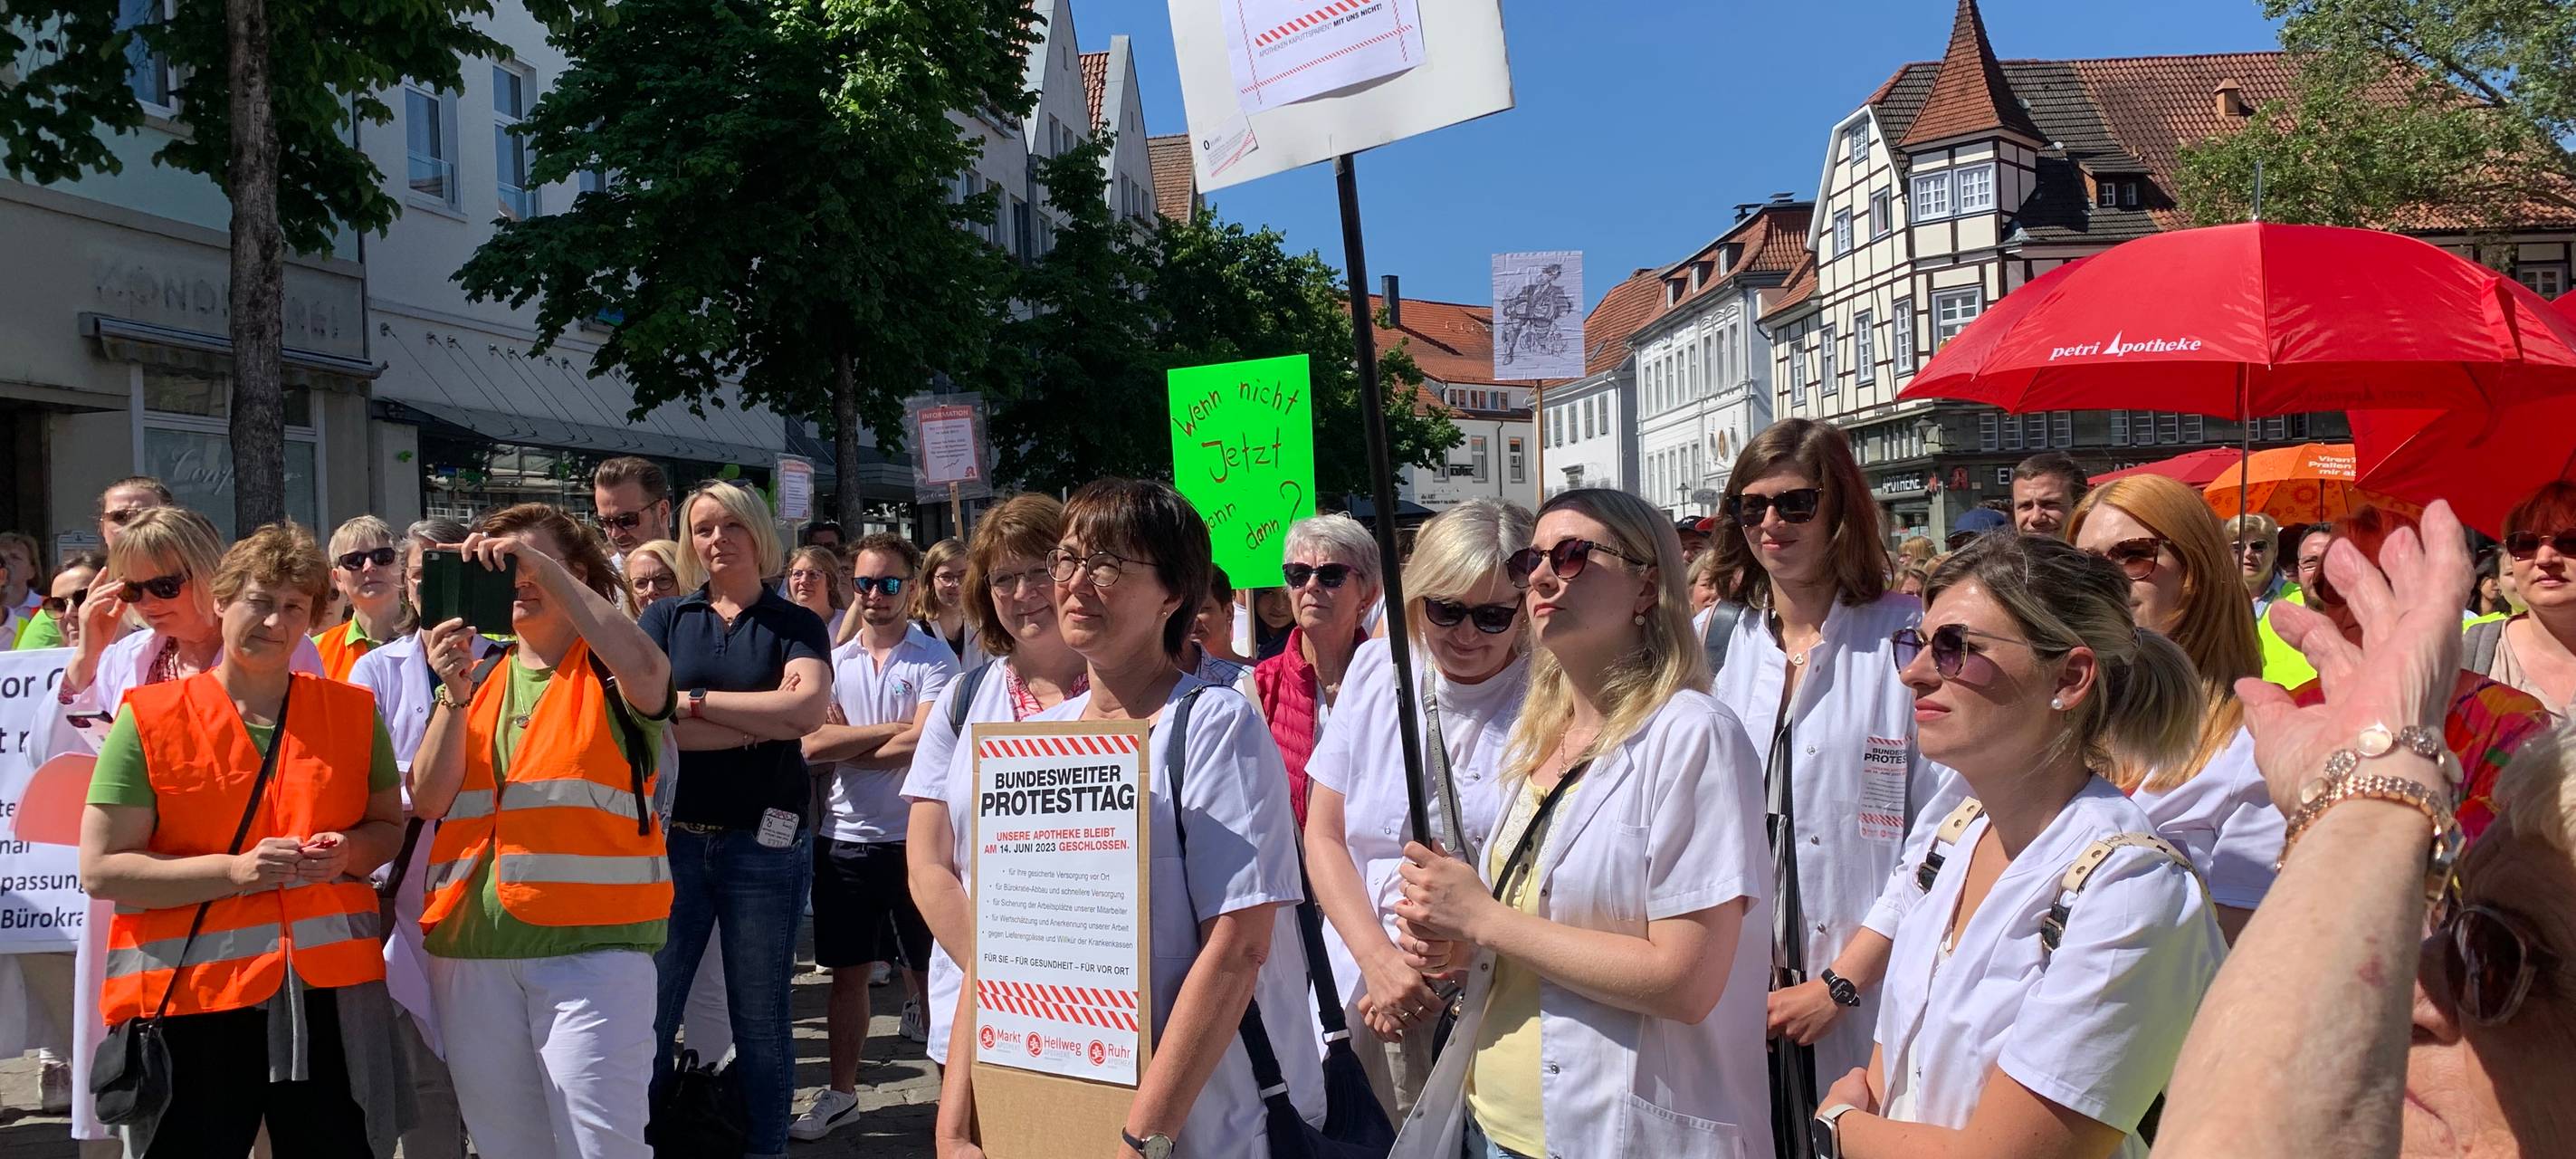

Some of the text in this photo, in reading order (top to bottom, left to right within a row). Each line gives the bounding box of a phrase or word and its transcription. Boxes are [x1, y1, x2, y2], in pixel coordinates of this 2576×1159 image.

[1333, 18, 1345, 28] MIT
[1346, 12, 1360, 23] UNS
[1360, 3, 1383, 17] NICHT!
[2048, 341, 2101, 361] petri
[1238, 378, 1300, 415] nicht
[921, 409, 968, 420] INFORMATION
[1201, 426, 1282, 484] Jetzt
[2308, 460, 2352, 469] Prallen
[1882, 472, 1921, 494] APOTHEKE
[1245, 519, 1281, 551] dann
[1, 675, 36, 699] or
[1865, 752, 1906, 764] PROTES
[1873, 747, 1905, 755] BUNDES
[996, 764, 1121, 790] BUNDESWEITER
[981, 783, 1135, 817] PROTESTTAG
[997, 828, 1115, 841] UNSERE APOTHEKE BLEIBT
[984, 839, 1130, 854] AM 14. JUNI 2023 GESCHLOSSEN.
[1017, 868, 1026, 876] Ihre
[1027, 869, 1054, 878] gesicherte
[1057, 871, 1088, 881] Versorgung
[1100, 873, 1110, 881] Ort
[1061, 887, 1091, 896] schnellere
[1092, 889, 1125, 900] Versorgung
[1001, 899, 1026, 909] Sicherung
[1027, 900, 1036, 908] der
[1037, 902, 1073, 912] Arbeitsplätze
[1096, 906, 1128, 915] Mitarbeiter
[999, 915, 1038, 926] Wertschätzung
[1039, 917, 1049, 925] und
[1050, 919, 1087, 931] Anerkennung
[1088, 922, 1111, 931] unserer
[1111, 924, 1129, 933] Arbeit
[987, 930, 1004, 939] gegen
[1045, 934, 1055, 943] und
[1057, 935, 1076, 944] Willkür
[1077, 937, 1087, 945] der
[1088, 938, 1133, 949] Krankenkassen
[984, 953, 1130, 976] FÜR SIE FÜR GESUNDHEIT FÜR VOR ORT
[997, 1029, 1021, 1044] Markt
[1044, 1035, 1082, 1057] Hellweg
[1108, 1043, 1131, 1059] Ruhr
